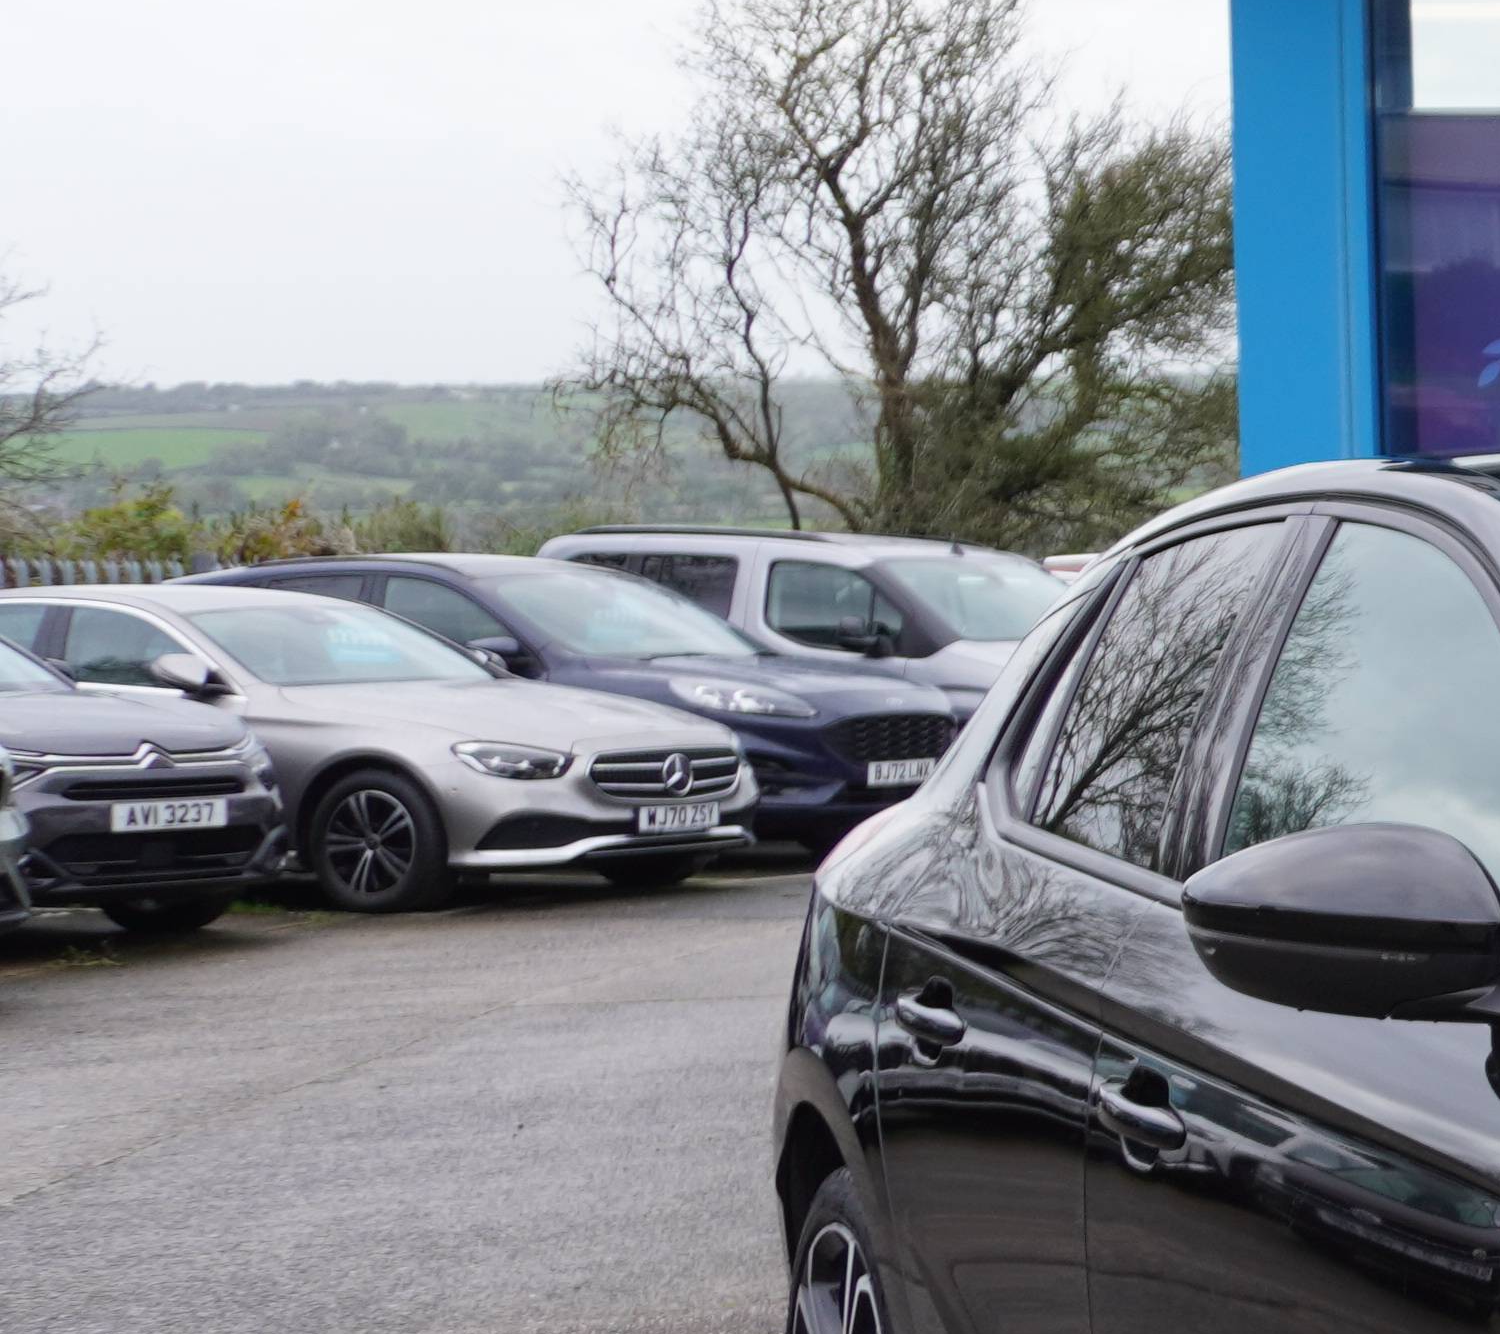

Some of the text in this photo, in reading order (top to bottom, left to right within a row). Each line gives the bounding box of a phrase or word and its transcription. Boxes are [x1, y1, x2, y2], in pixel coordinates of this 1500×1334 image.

[127, 802, 214, 826] AVI 3237
[647, 803, 714, 826] WJ70 ZSY
